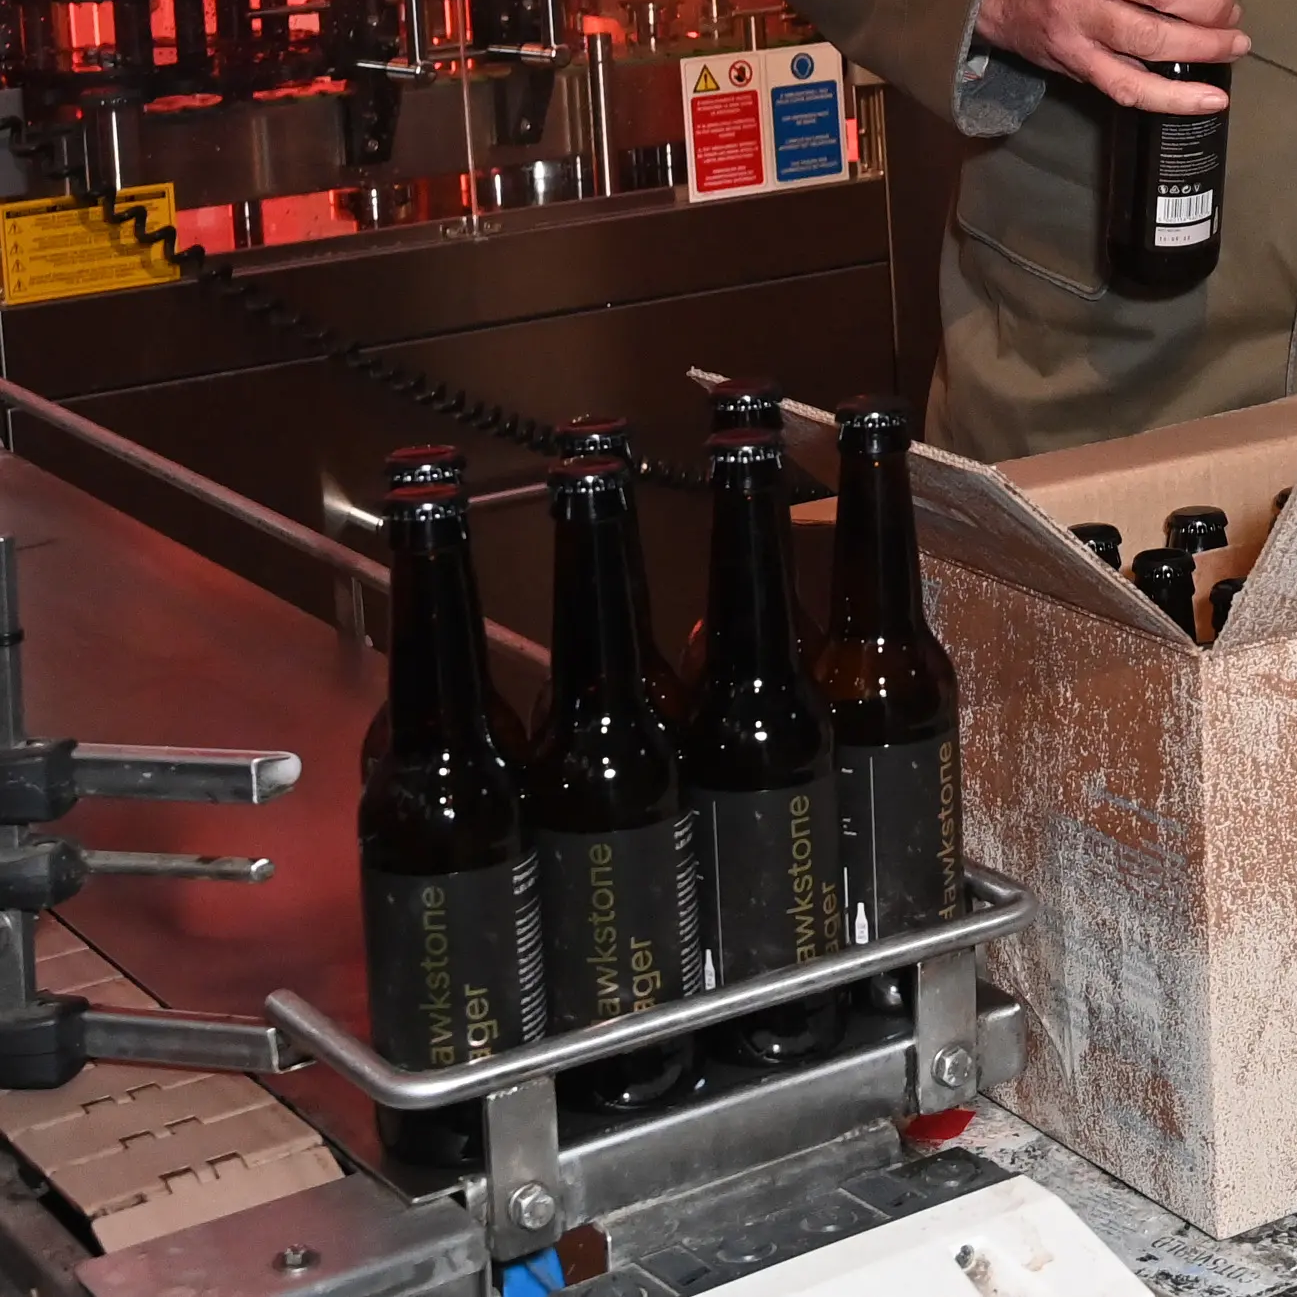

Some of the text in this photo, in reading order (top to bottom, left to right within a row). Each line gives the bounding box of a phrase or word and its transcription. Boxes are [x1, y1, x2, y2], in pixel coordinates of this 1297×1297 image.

[586, 843, 620, 1025] awkstone
[786, 794, 817, 964] awkstone
[821, 880, 841, 955] ager
[419, 886, 455, 1065] awkstone
[463, 983, 499, 1062] ager
[630, 935, 661, 1012] ager
